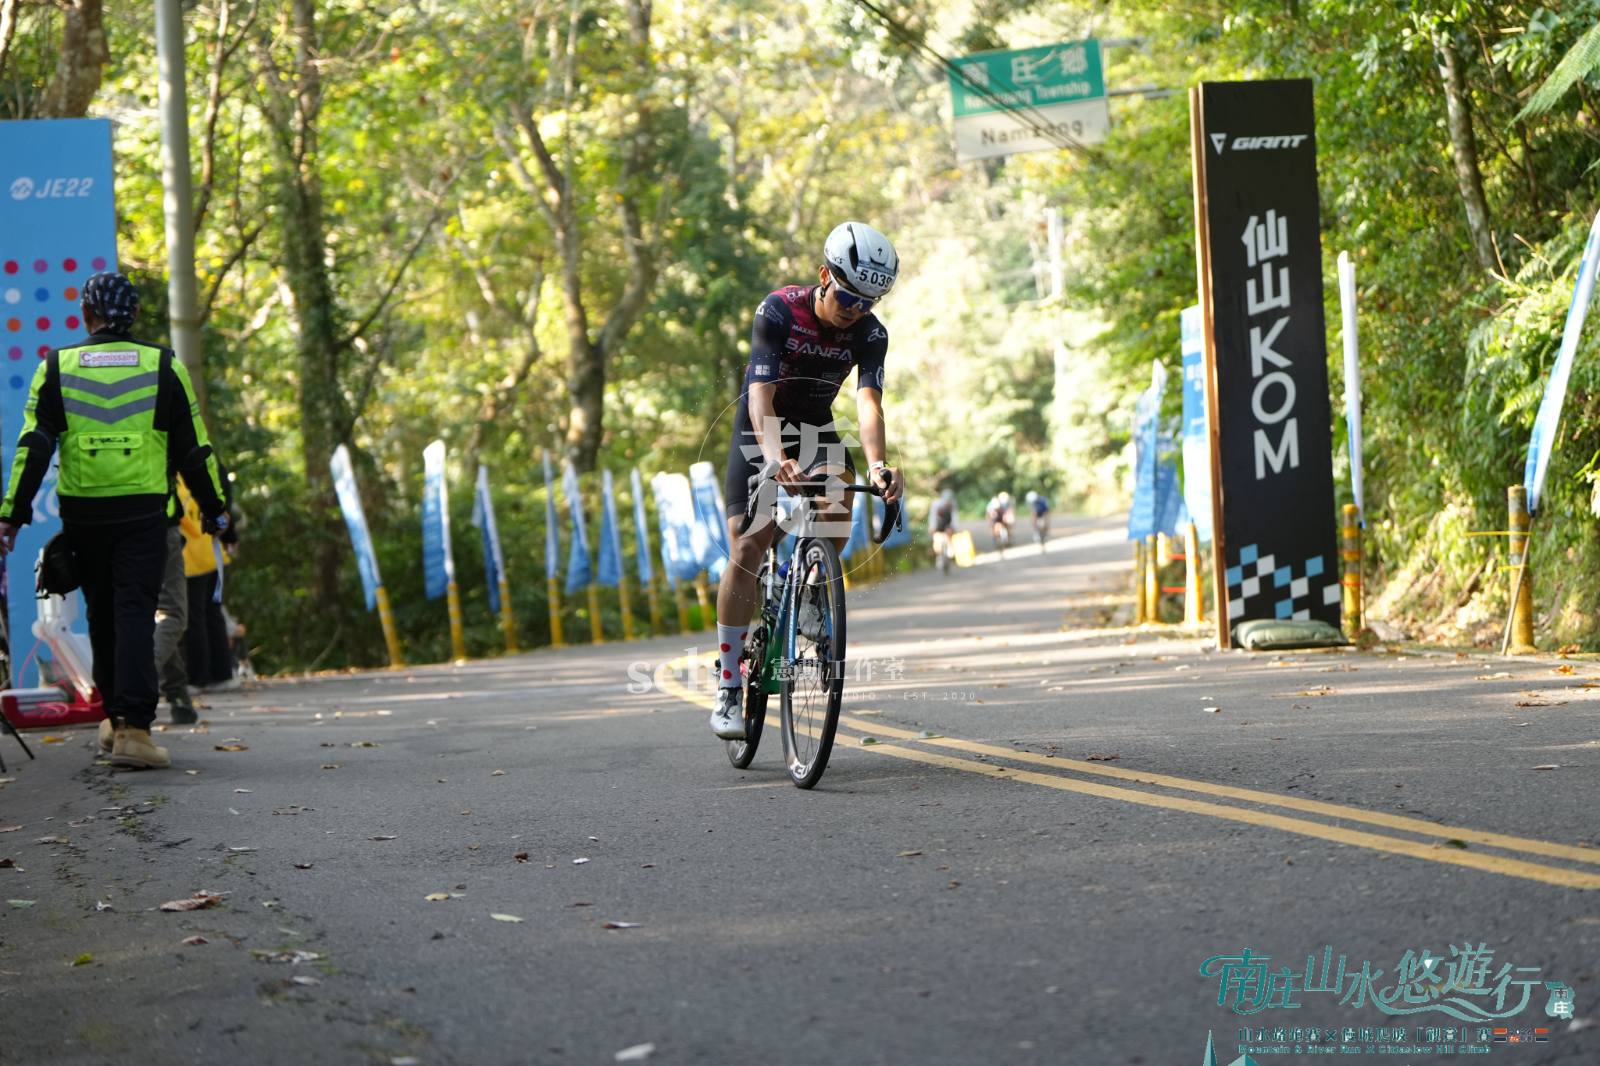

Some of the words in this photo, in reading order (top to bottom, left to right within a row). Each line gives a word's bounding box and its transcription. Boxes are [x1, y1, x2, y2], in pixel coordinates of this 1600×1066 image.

[1034, 81, 1091, 99] Township
[1231, 134, 1308, 150] GIANT
[35, 177, 94, 199] JE22
[81, 351, 137, 362] Commissaire
[785, 337, 853, 361] SANFA
